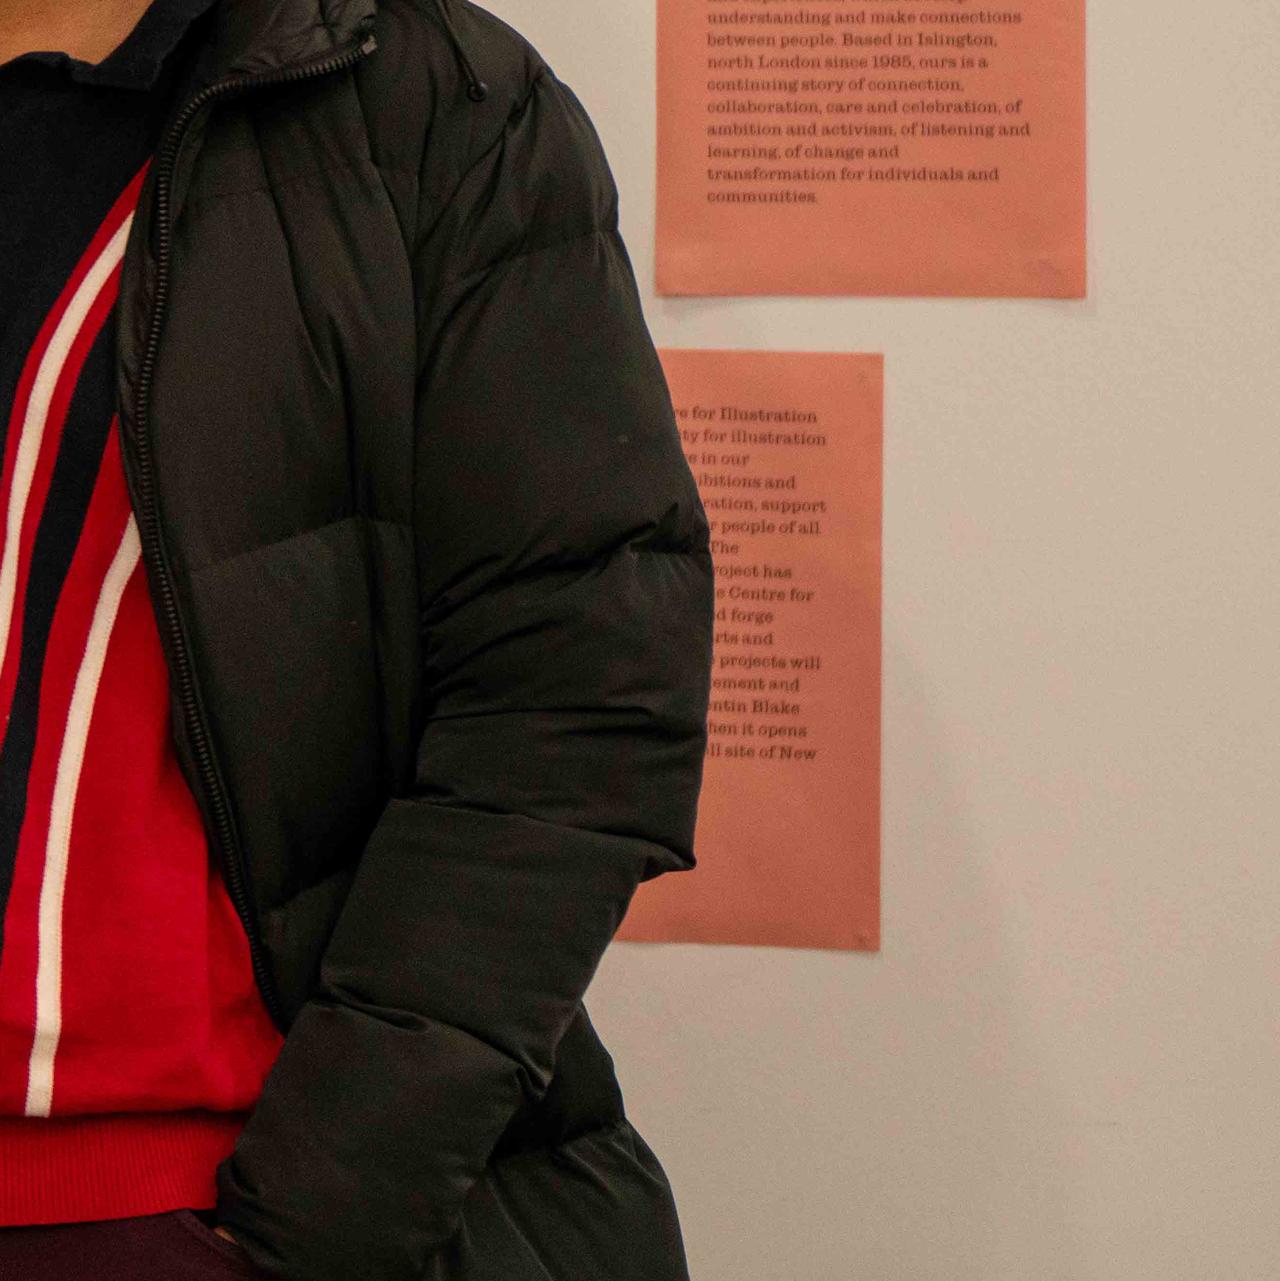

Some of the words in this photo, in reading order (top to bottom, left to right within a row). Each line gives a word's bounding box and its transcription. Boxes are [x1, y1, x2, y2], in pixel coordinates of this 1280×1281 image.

[708, 10, 830, 27] understanding
[835, 9, 865, 24] and
[871, 9, 915, 23] make
[920, 10, 1022, 23] connections
[707, 32, 775, 46] between
[842, 32, 892, 46] Based
[707, 54, 753, 68] north
[759, 54, 820, 68] London
[825, 55, 867, 68] since
[919, 58, 956, 68] ours
[707, 78, 798, 94] continuing
[801, 78, 843, 94] story
[826, 103, 862, 113] care
[867, 99, 897, 113] and
[707, 122, 781, 136] ambition
[786, 122, 816, 136] and
[921, 122, 994, 139] listening
[998, 122, 1030, 136] and
[804, 144, 864, 161] change
[868, 144, 899, 158] and
[707, 166, 836, 180] transformation
[840, 166, 864, 180] for
[868, 166, 964, 180] individuals
[967, 166, 999, 180] and
[692, 405, 715, 420] for
[720, 406, 817, 422] Illustration
[703, 429, 726, 443] for
[731, 429, 826, 444] illustration
[701, 452, 716, 465] in
[721, 455, 749, 465] our
[764, 474, 796, 488] and
[761, 498, 826, 514] support
[721, 519, 775, 535] people
[779, 519, 796, 533] of
[798, 518, 820, 533] all
[713, 564, 758, 579] roject
[763, 563, 792, 578] has
[729, 585, 785, 600] Centre
[790, 586, 813, 600] for
[731, 608, 773, 624] forge
[742, 630, 773, 644] and
[720, 654, 786, 670] projects
[790, 654, 821, 669] will
[769, 676, 800, 690] and
[752, 699, 799, 713] Blake
[742, 723, 753, 736] it
[758, 726, 807, 738] opens
[724, 745, 755, 758] site
[759, 744, 776, 758] of
[779, 744, 816, 758] New
